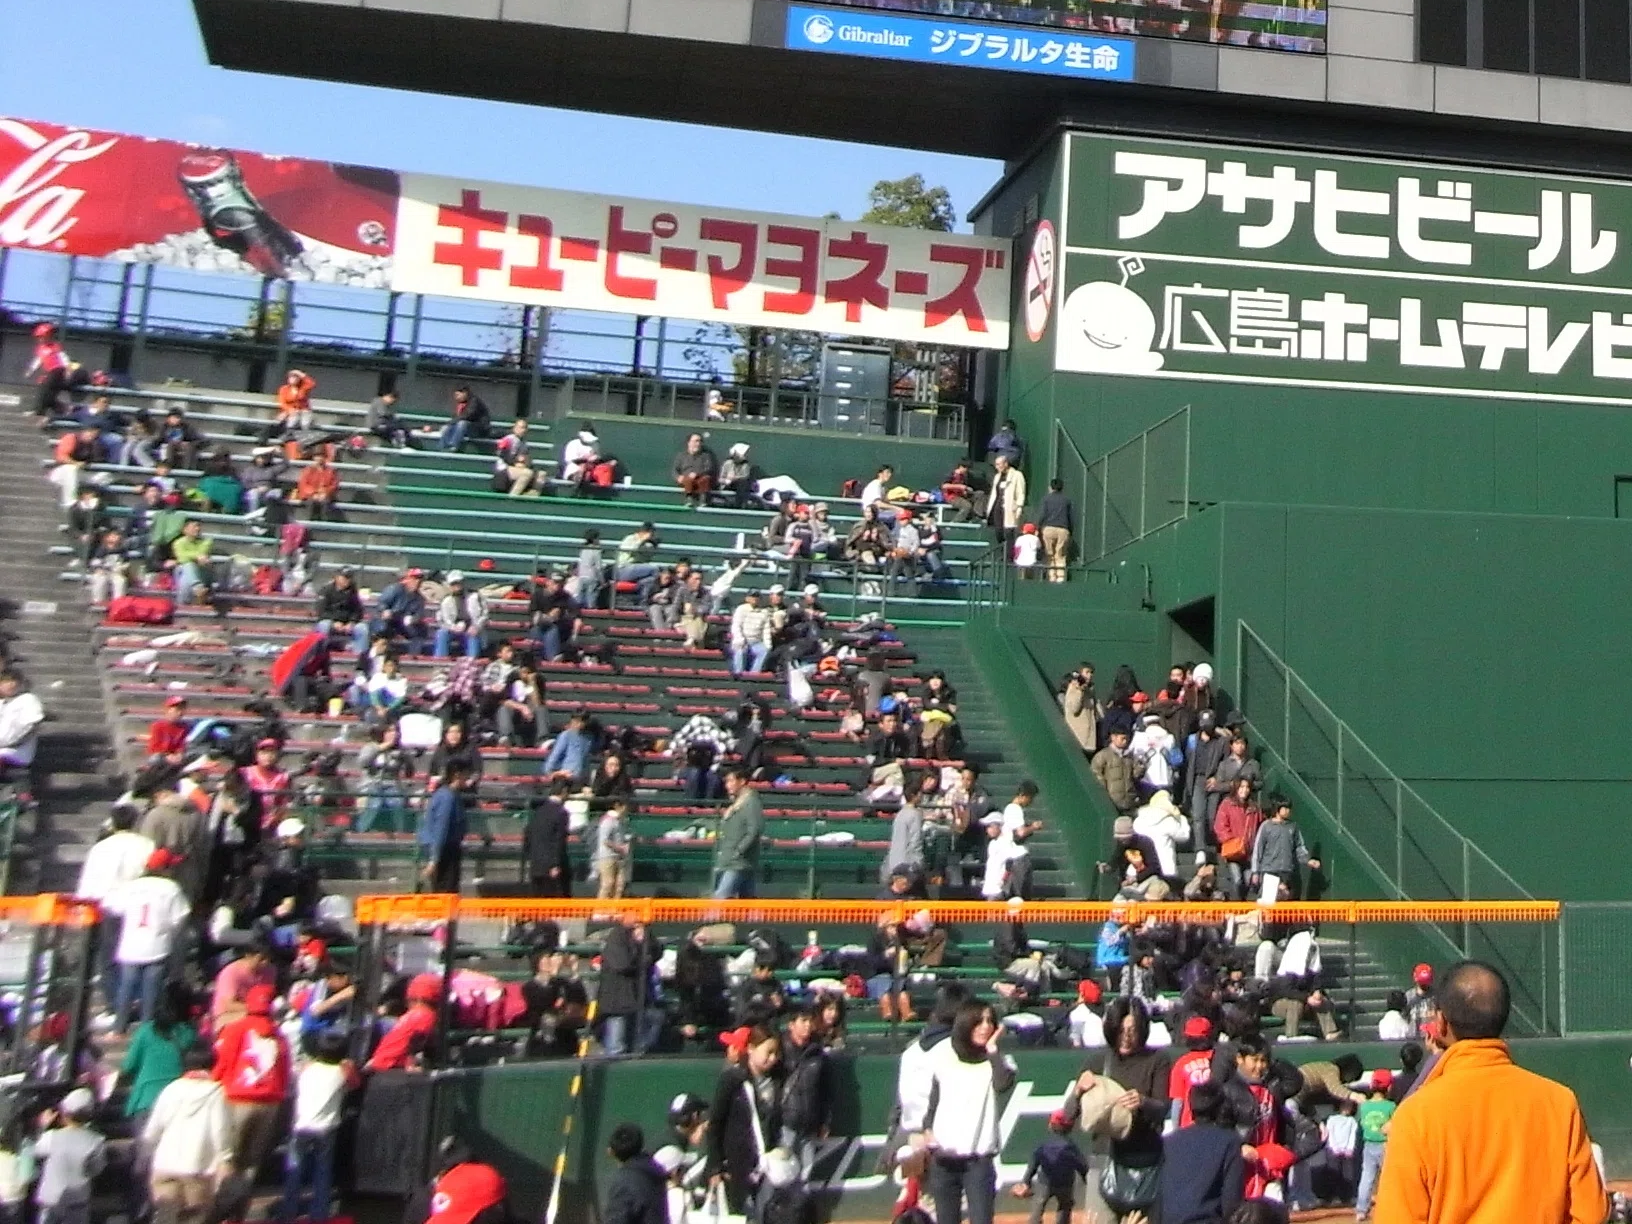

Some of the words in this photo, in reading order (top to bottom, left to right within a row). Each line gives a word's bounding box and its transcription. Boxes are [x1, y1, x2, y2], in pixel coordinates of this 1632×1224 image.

[838, 24, 913, 47] Gibraltar
[929, 29, 1120, 72] ジブラルタ生命
[433, 188, 1005, 333] キューピーマヨネーズ
[1114, 151, 1617, 274] アサヒビール
